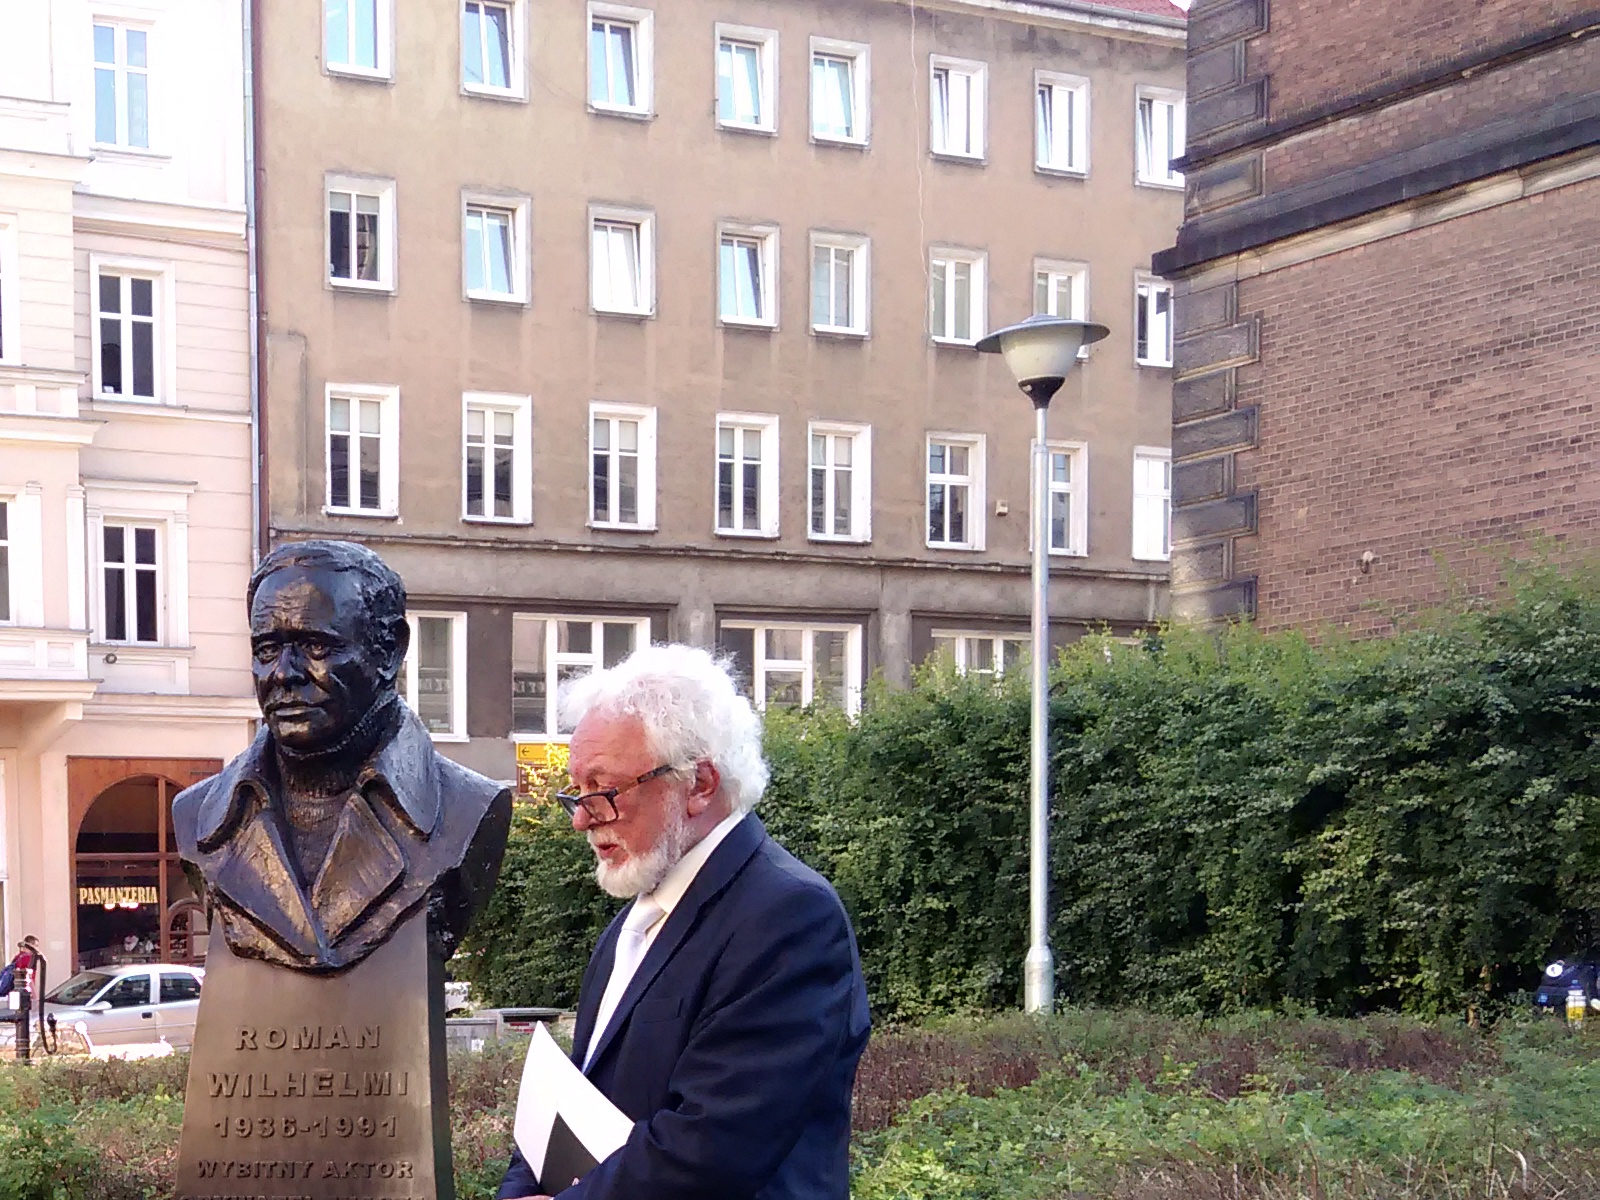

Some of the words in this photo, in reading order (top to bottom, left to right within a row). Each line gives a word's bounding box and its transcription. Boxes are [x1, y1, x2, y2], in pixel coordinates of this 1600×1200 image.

[79, 886, 158, 905] PASMANTERIA
[235, 1024, 381, 1051] ROMAN
[208, 1071, 408, 1098] WILHELMI
[214, 1115, 398, 1138] 1936-1991
[197, 1160, 314, 1179] WYBITNY
[321, 1160, 414, 1179] AKTOR
